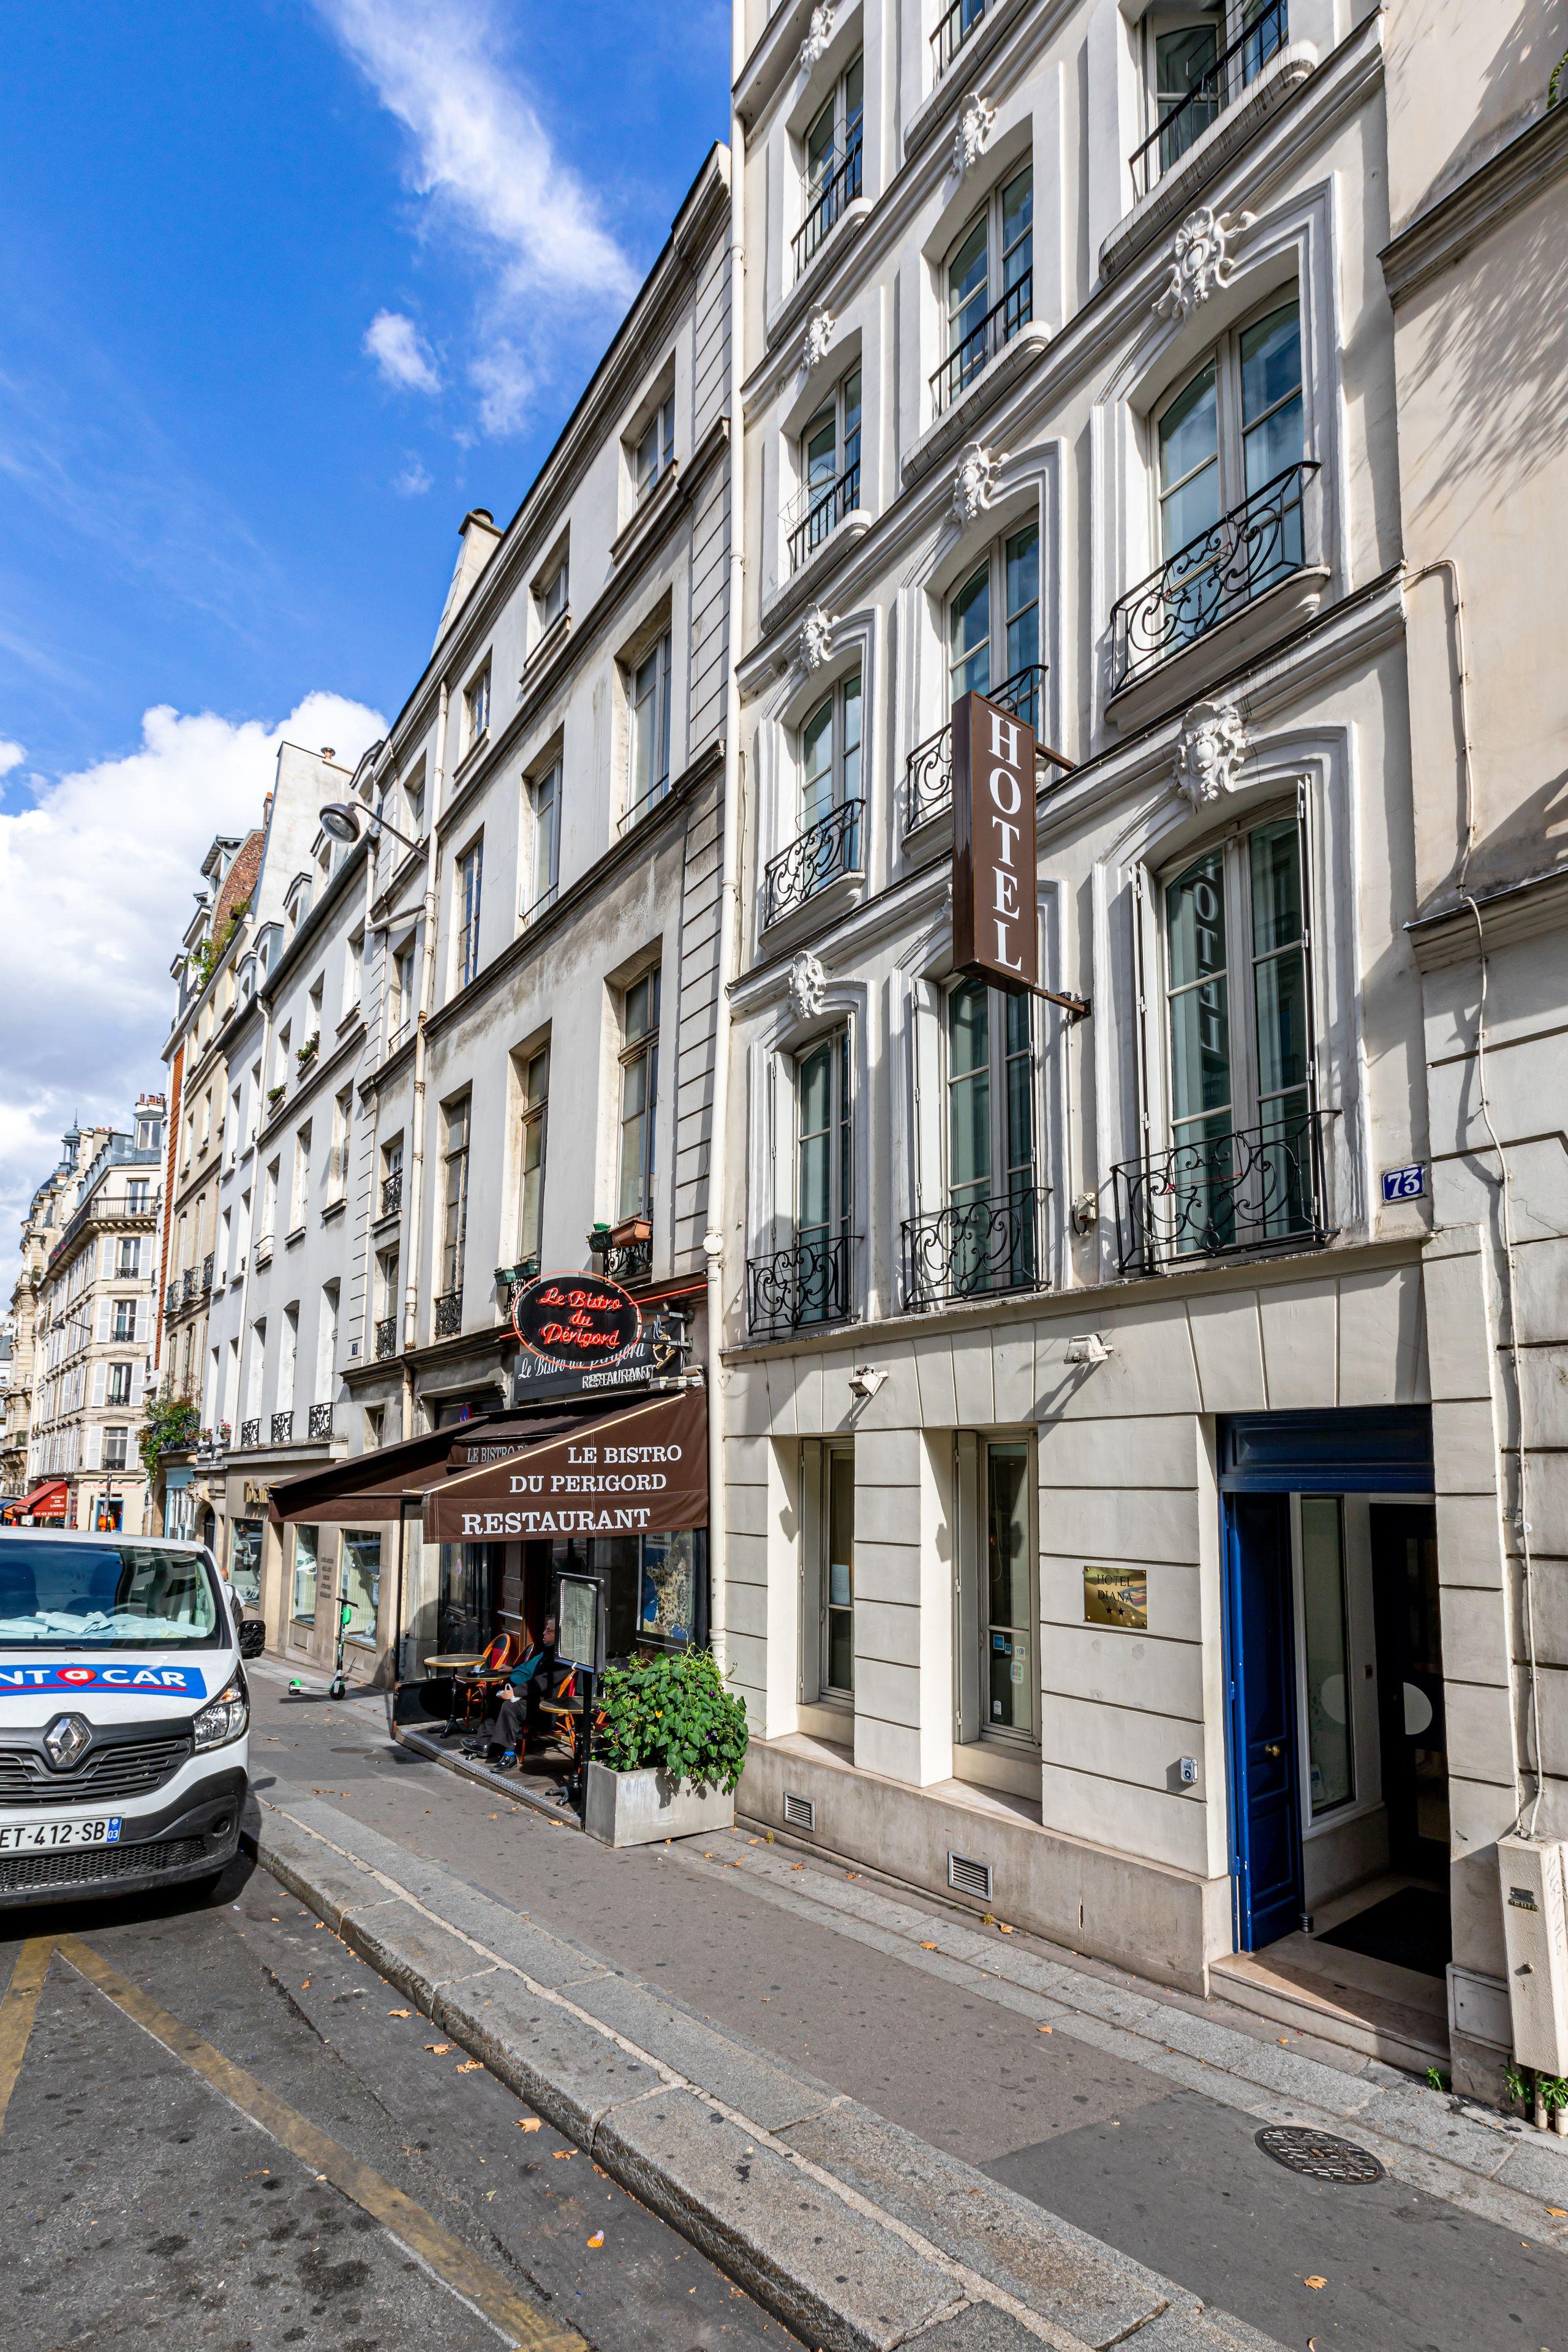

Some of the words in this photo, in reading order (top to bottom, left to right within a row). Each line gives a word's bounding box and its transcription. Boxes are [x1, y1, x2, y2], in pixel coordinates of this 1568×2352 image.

[988, 710, 1022, 971] HOTEL
[1387, 1169, 1420, 1198] 73
[539, 1287, 565, 1305] Le
[568, 1291, 622, 1310] Bistro
[570, 1310, 594, 1327] du
[518, 1357, 532, 1379] Le
[582, 1364, 656, 1389] RESTAURANT
[467, 1447, 479, 1463] LE
[568, 1447, 597, 1464] LE
[603, 1445, 682, 1464] BISTRO
[510, 1475, 545, 1493] DU
[551, 1474, 667, 1492] PERIGORD
[461, 1507, 650, 1535] RESTAURANT
[1097, 1574, 1134, 1587] HOTEL
[1097, 1589, 1134, 1603] DIANA
[64, 1670, 89, 1680] a
[102, 1669, 187, 1687] CAR
[108, 1829, 119, 1839] 03
